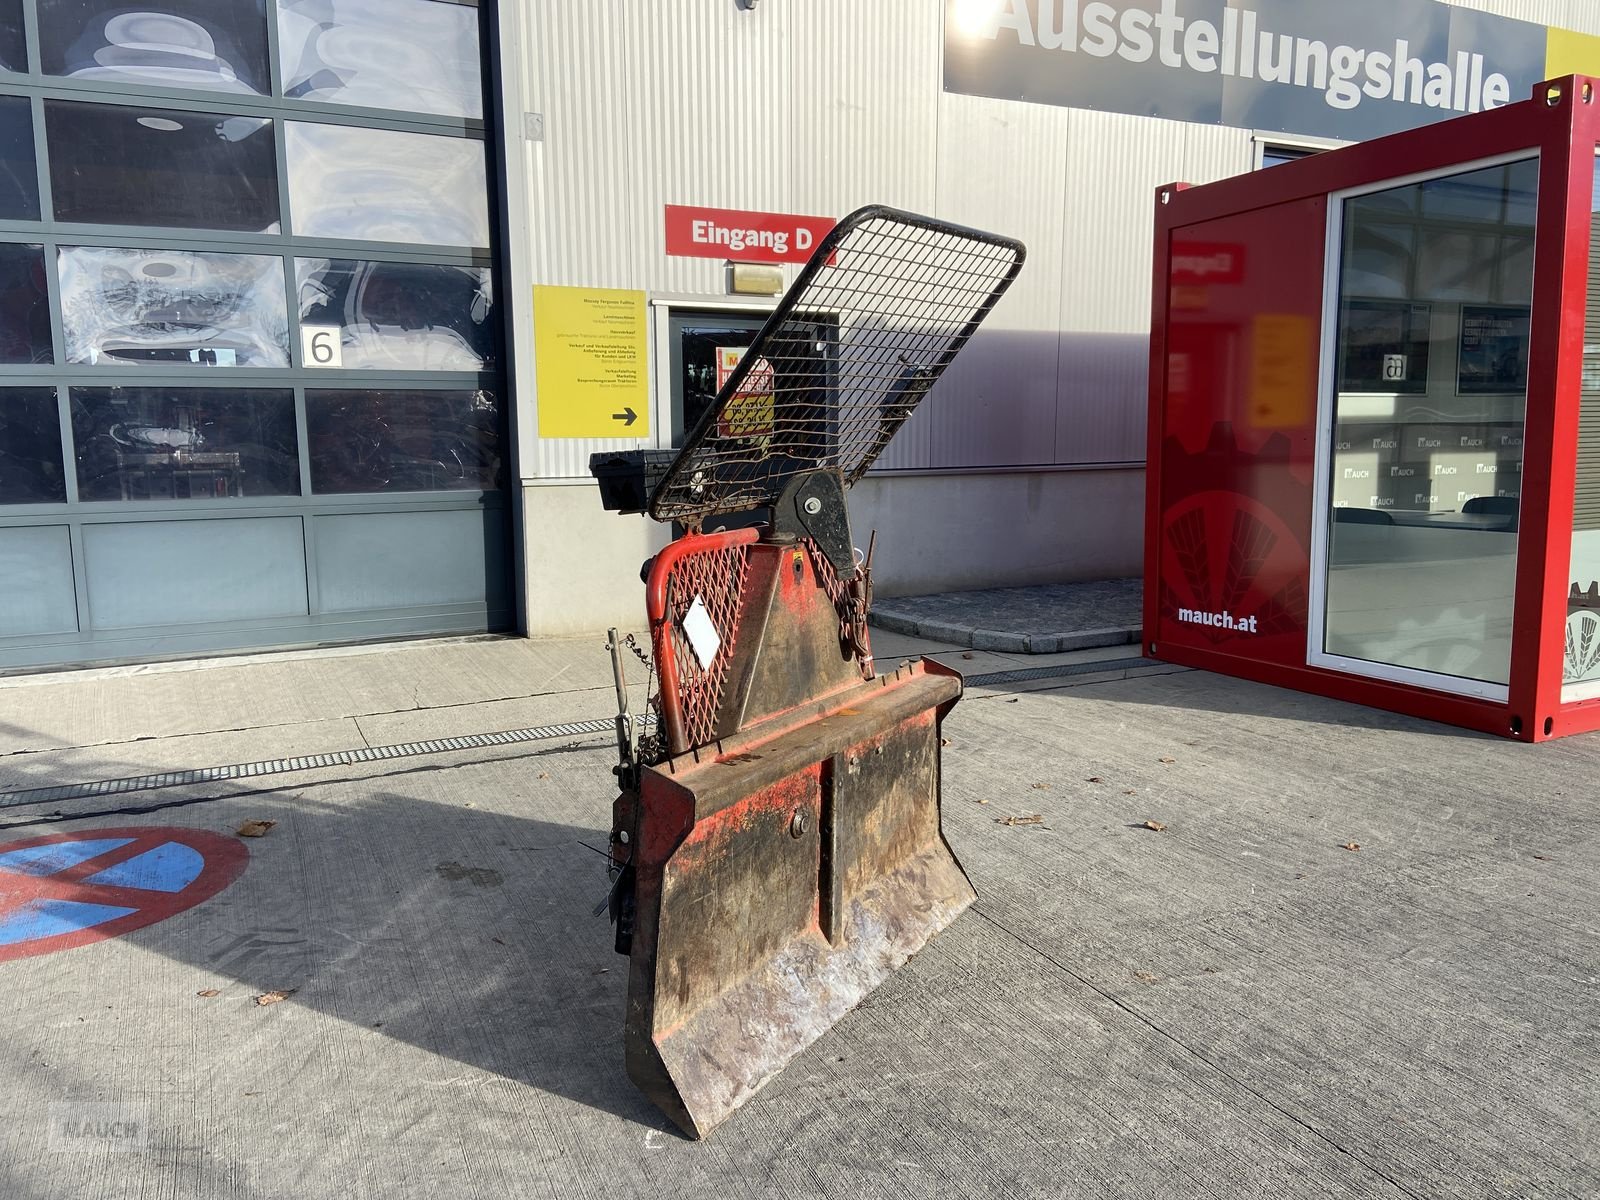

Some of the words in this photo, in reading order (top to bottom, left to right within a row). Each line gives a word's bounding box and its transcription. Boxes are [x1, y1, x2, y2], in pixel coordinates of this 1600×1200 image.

[981, 0, 1510, 113] Ausstellungshalle
[692, 219, 789, 254] Eingang
[796, 228, 813, 250] D
[311, 332, 333, 363] 6
[1178, 607, 1258, 633] mauch.at
